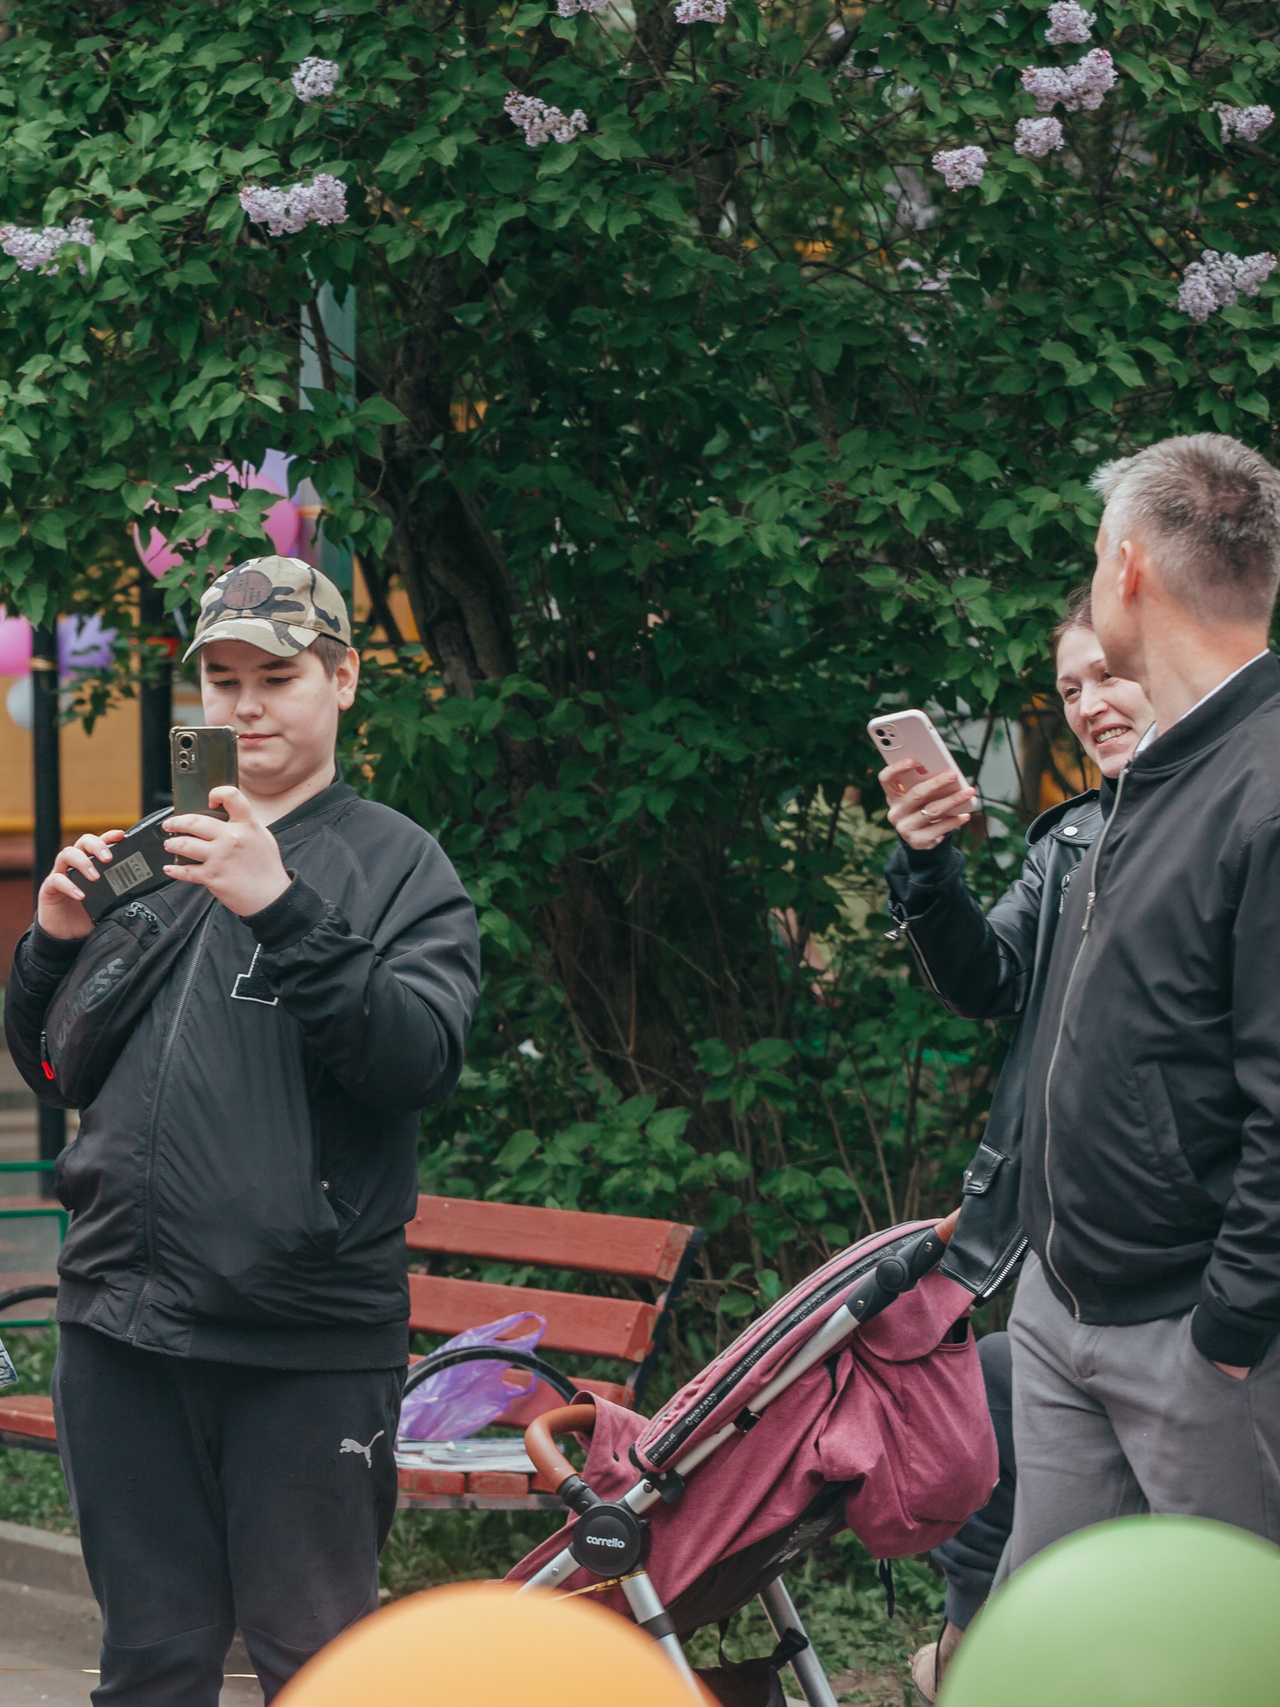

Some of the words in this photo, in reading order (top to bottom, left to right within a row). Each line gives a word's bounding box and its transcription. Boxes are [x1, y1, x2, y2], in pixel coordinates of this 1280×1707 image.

[790, 1291, 827, 1322] carrello
[684, 1392, 718, 1426] carrello
[586, 1535, 626, 1549] carrello
